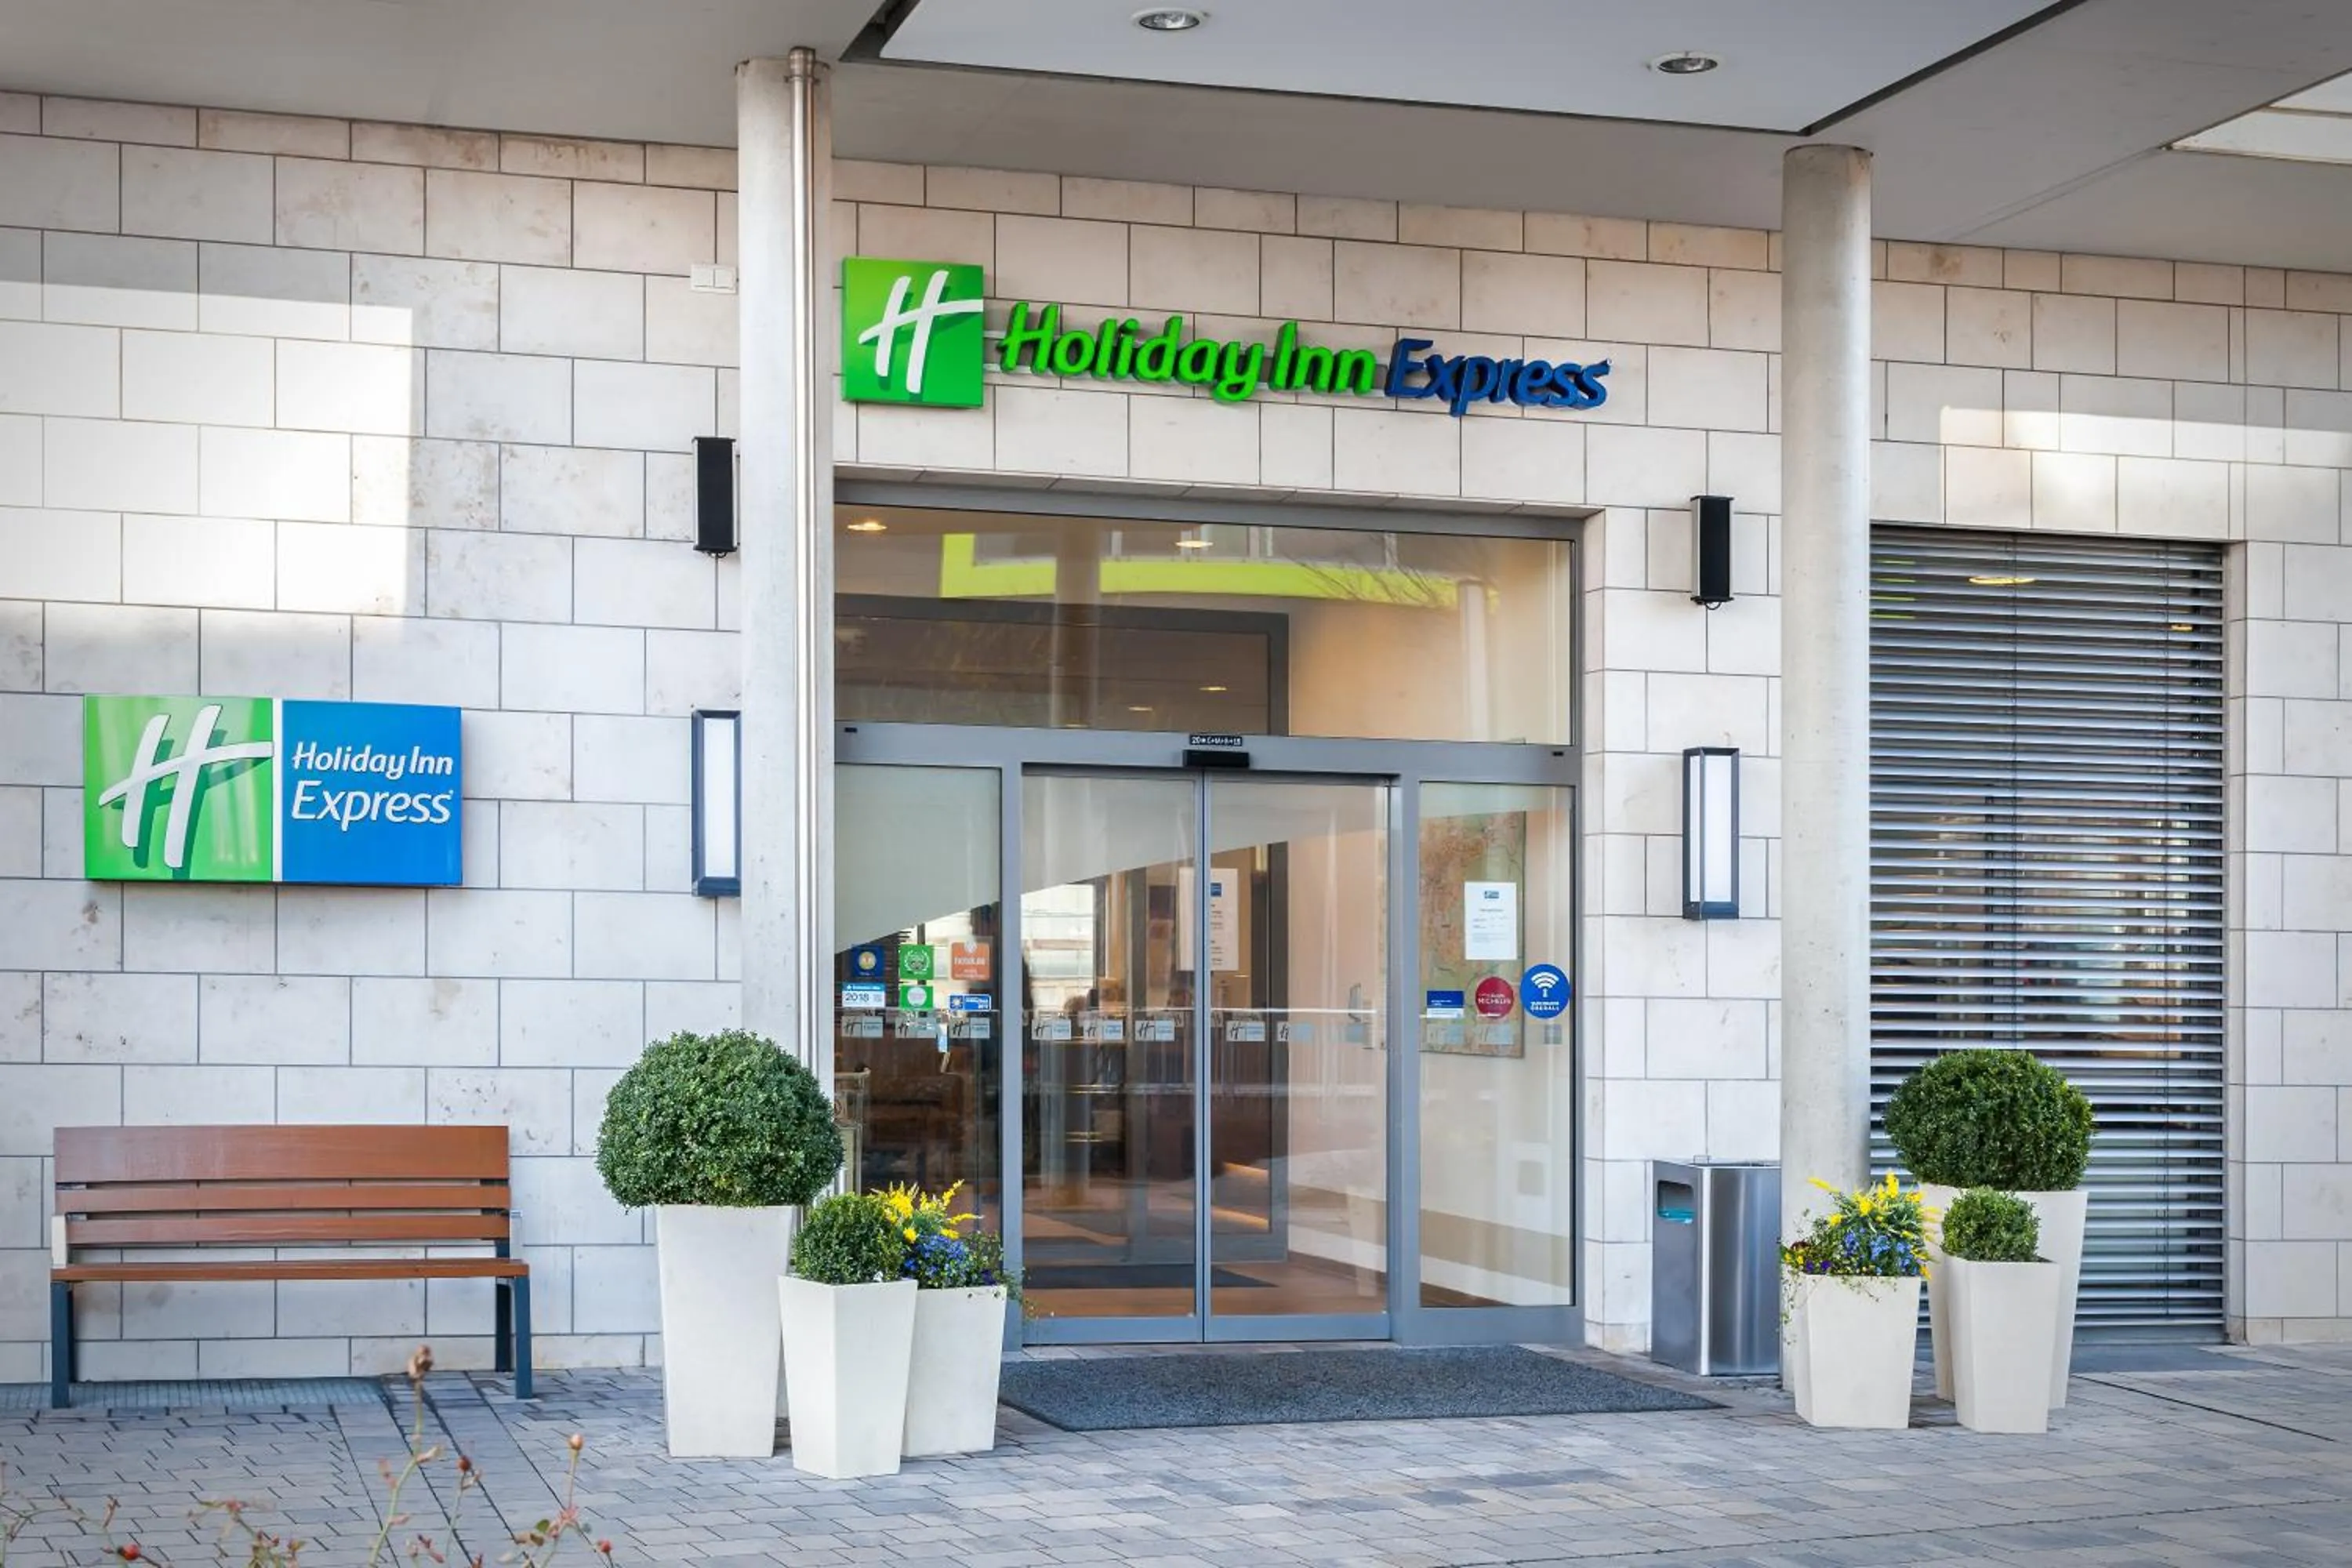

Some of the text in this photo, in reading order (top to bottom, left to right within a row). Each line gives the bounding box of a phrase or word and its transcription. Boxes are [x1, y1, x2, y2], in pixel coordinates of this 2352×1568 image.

[997, 301, 1611, 418] Holiday Inn Express
[292, 741, 454, 780] Holiday Inn
[291, 780, 454, 832] Express
